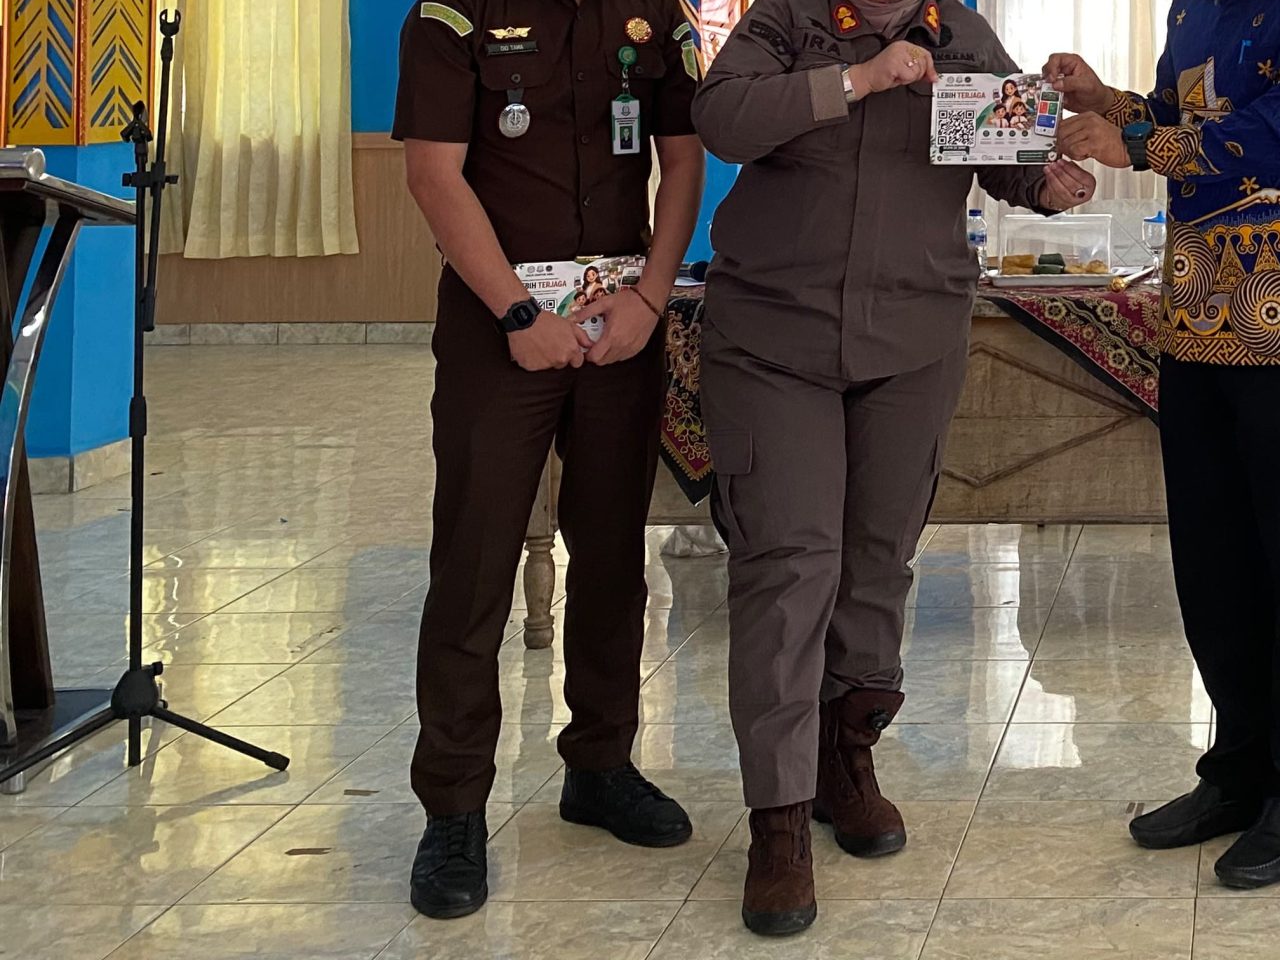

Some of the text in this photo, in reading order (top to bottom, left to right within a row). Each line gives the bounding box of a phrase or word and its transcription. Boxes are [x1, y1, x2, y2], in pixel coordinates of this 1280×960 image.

[802, 32, 841, 57] IRA
[936, 91, 956, 99] LEBIH
[538, 280, 567, 289] TERJAGA
